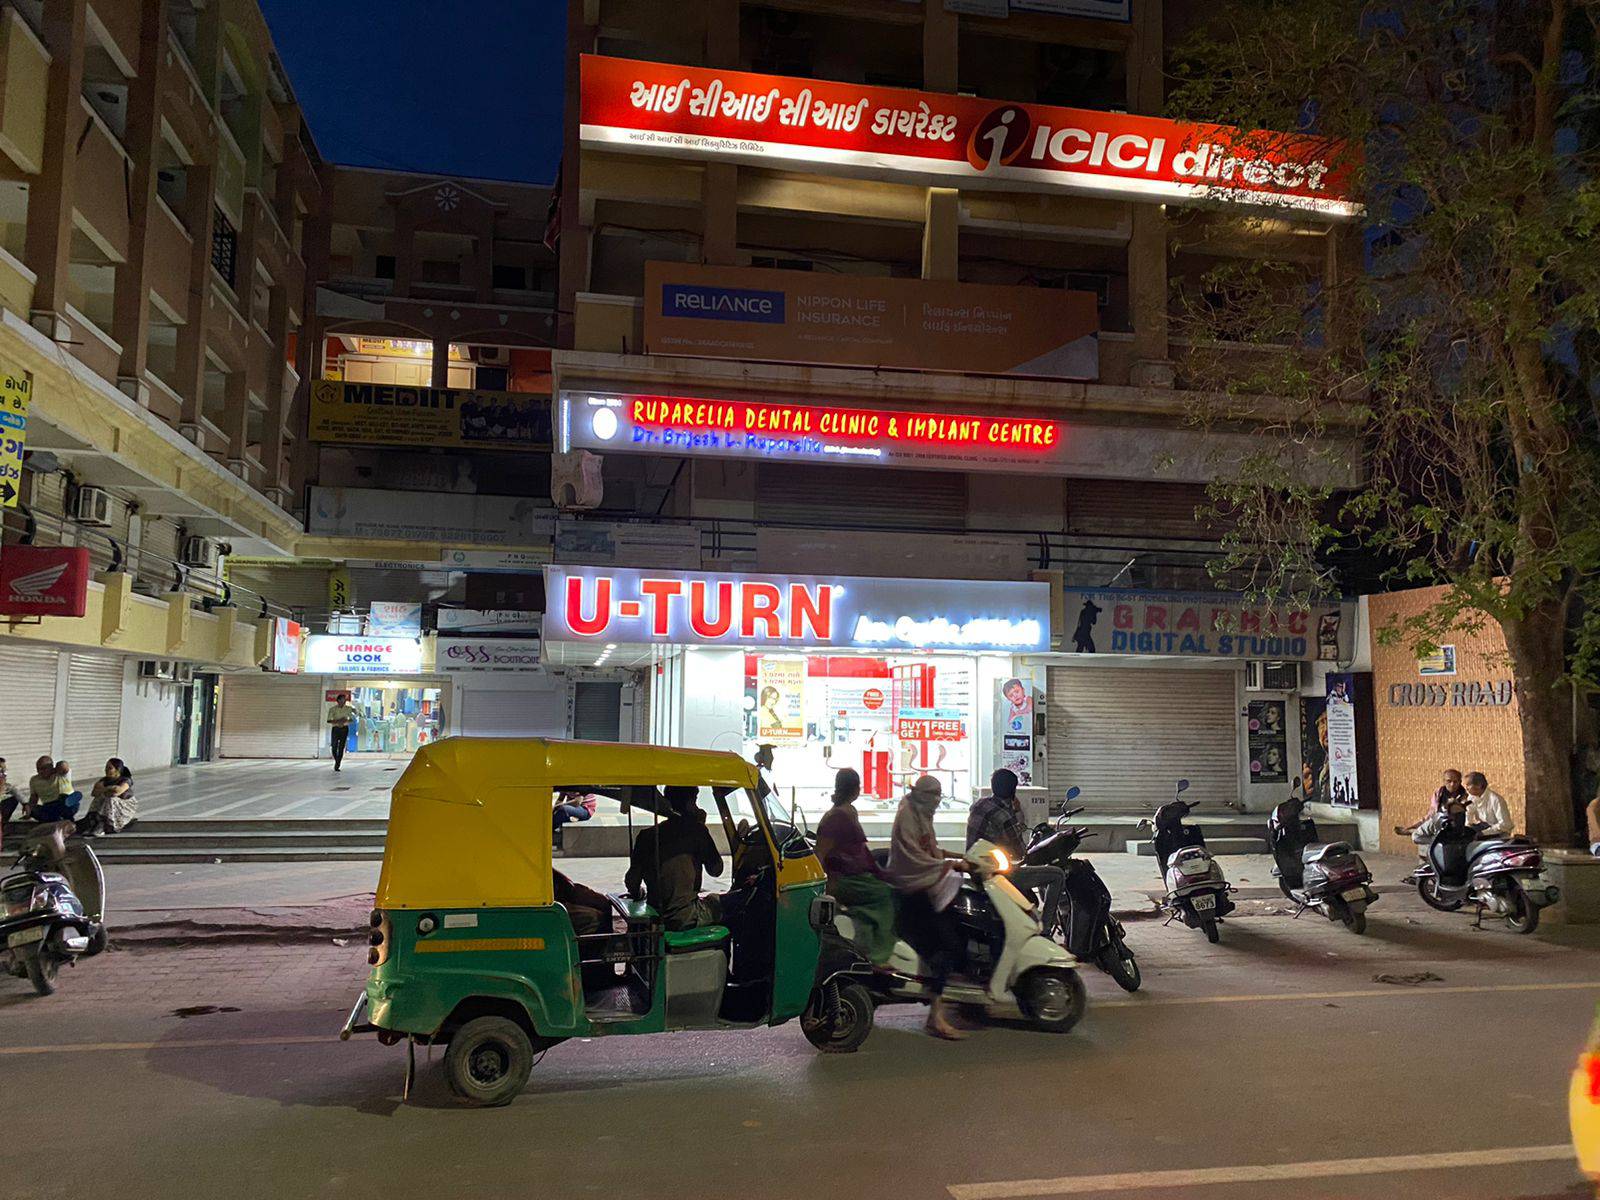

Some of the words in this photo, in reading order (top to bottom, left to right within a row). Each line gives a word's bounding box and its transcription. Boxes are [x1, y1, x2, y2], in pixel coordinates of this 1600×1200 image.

[1031, 126, 1166, 173] ICICI
[1172, 143, 1327, 190] direct
[797, 295, 851, 309] NIPPON
[856, 299, 887, 312] LIFE
[797, 312, 881, 327] INSURANCE
[634, 401, 734, 428] RUPARELIA
[745, 408, 811, 432] DENTAL
[820, 413, 879, 436] CLINIC
[888, 418, 899, 438] &
[907, 418, 980, 440] IMPLANT
[988, 422, 1054, 445] CENTRE
[633, 426, 659, 443] Dr.
[9, 595, 66, 604] HONDA
[565, 576, 831, 640] U-TURN
[338, 644, 393, 653] CHANGE
[1112, 630, 1210, 653] DIGITAL
[1218, 635, 1306, 656] STUDIO
[347, 654, 381, 662] LOOK
[1389, 683, 1447, 707] CROSS
[1452, 680, 1513, 706] ROAD
[901, 721, 921, 729] BUY
[921, 721, 930, 738] 1
[931, 721, 959, 730] FREE
[901, 729, 920, 738] GET
